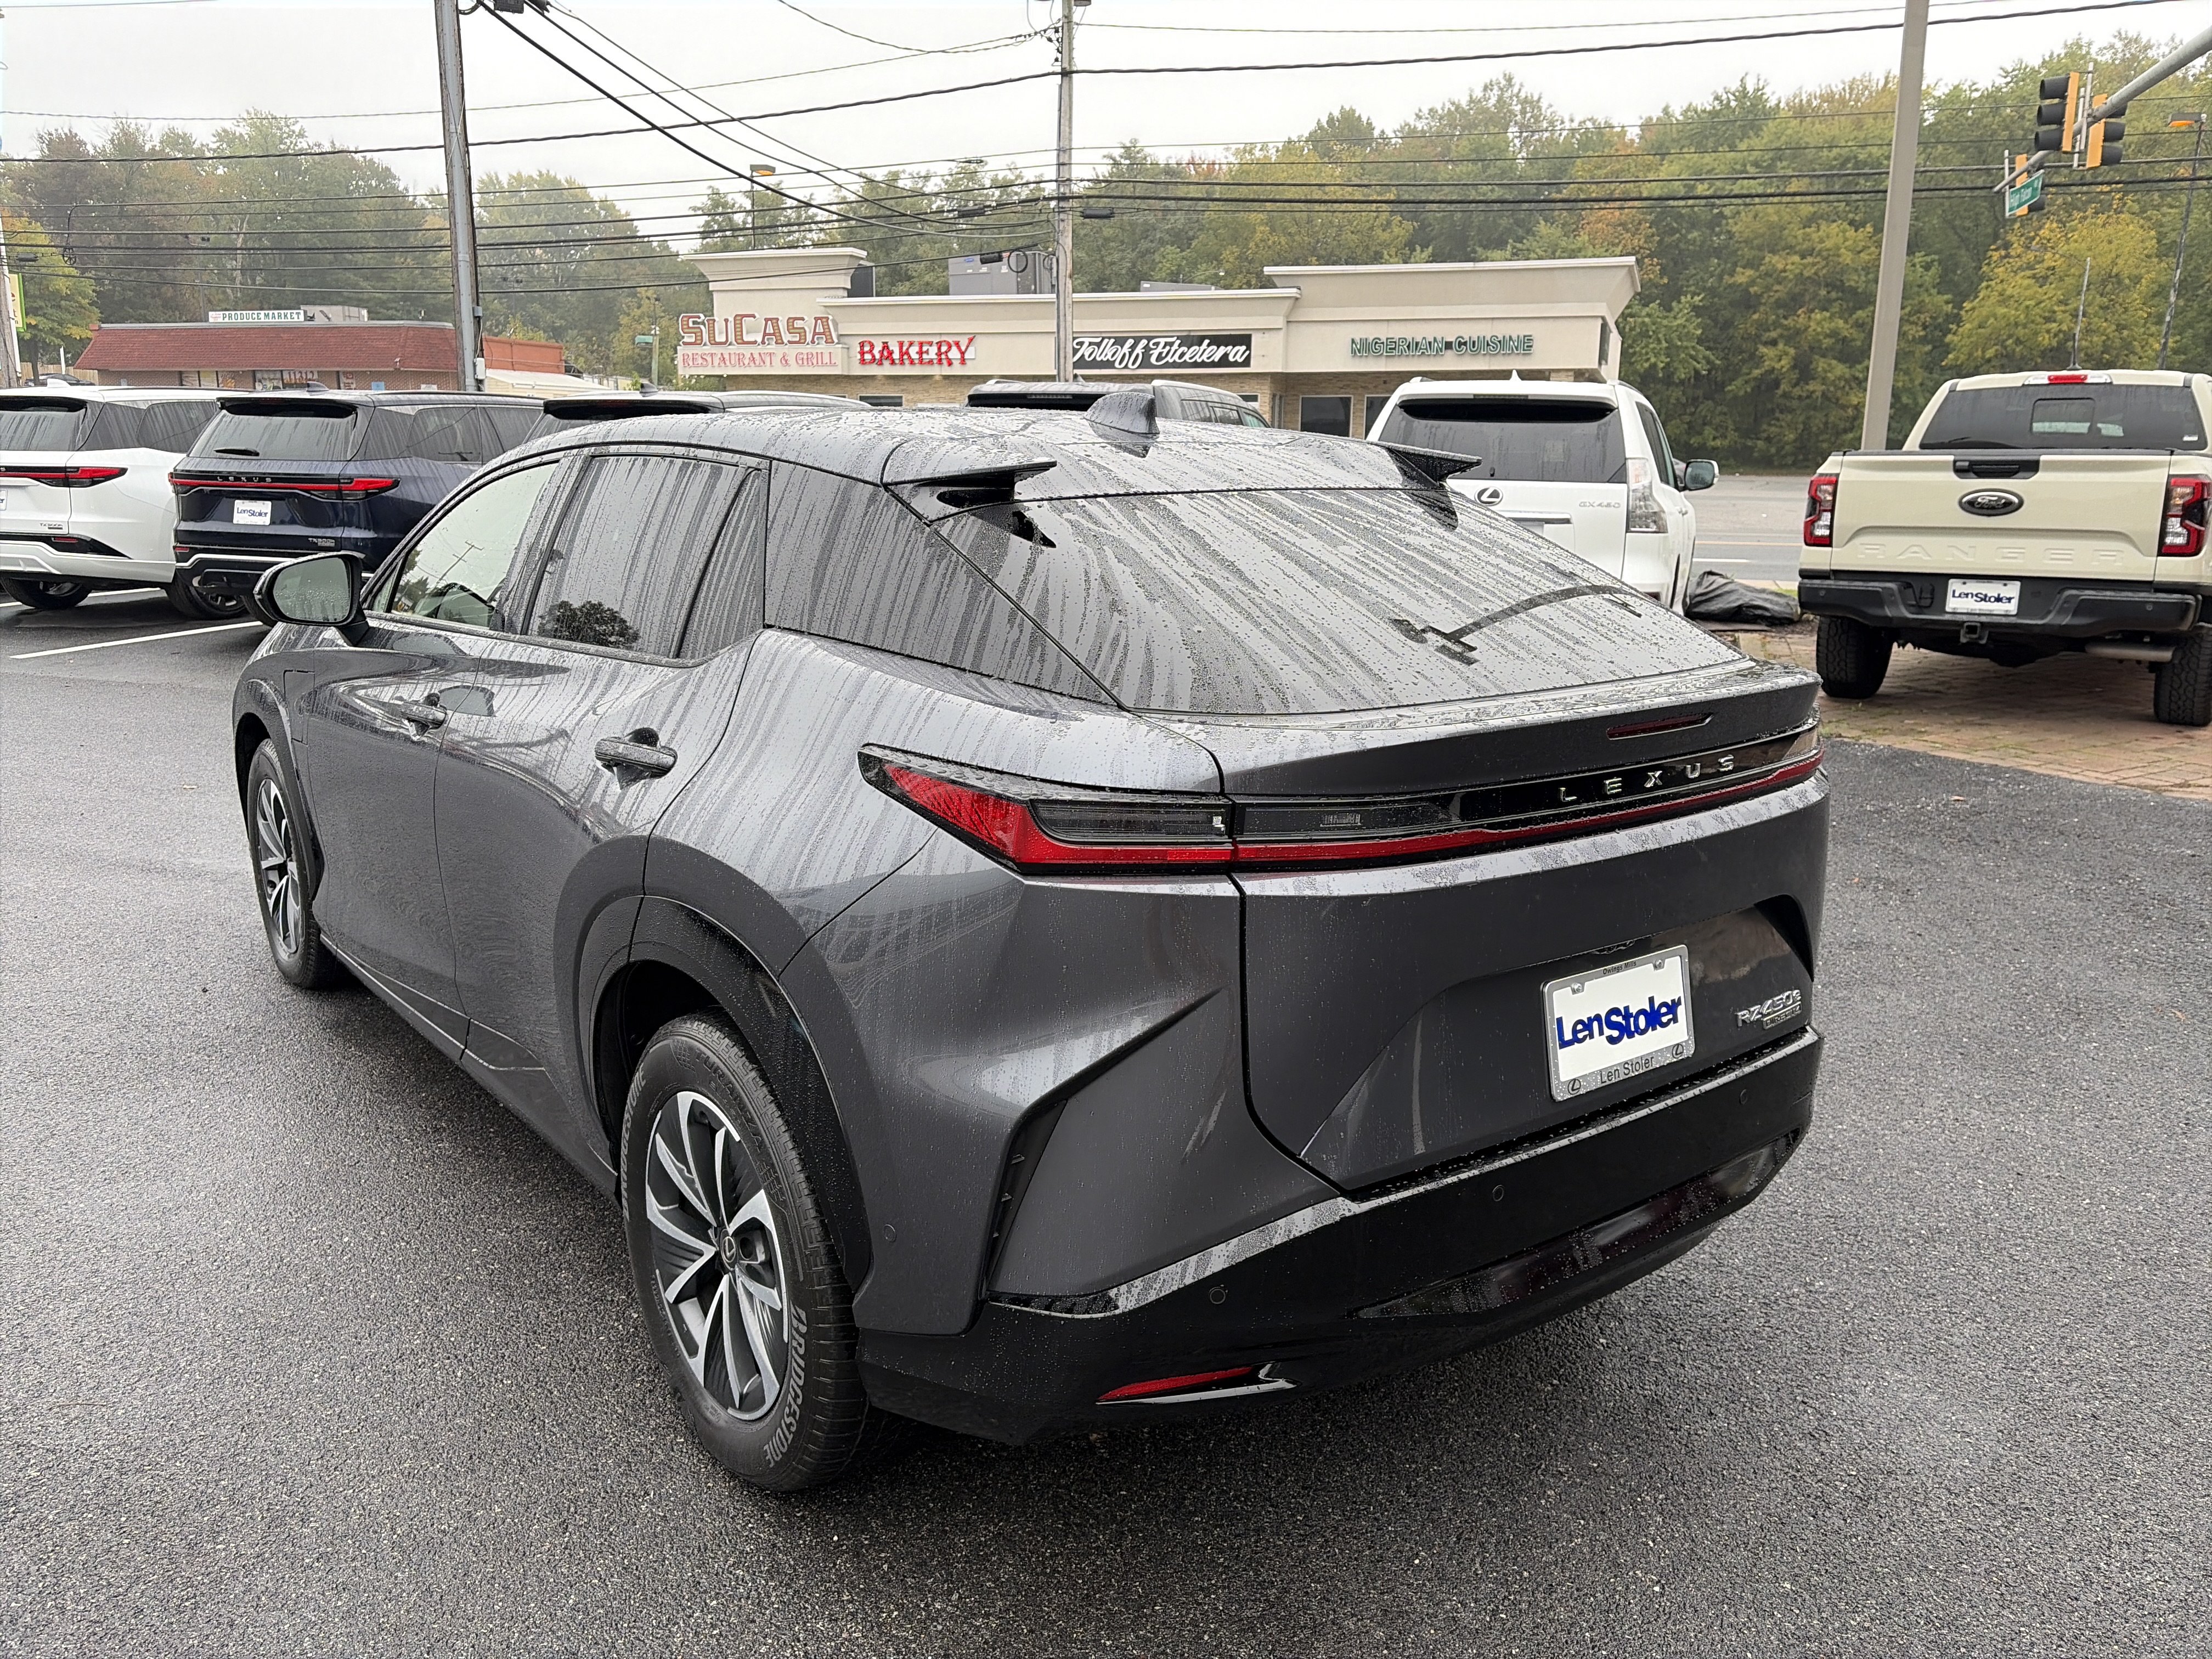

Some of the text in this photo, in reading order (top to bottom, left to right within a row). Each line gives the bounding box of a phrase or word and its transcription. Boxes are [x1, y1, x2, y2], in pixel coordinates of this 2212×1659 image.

[222, 312, 262, 321] PRODUCE
[264, 312, 301, 320] MARKET
[858, 335, 976, 366] BAKERY
[1149, 336, 1250, 365] Etcetera
[1350, 334, 1534, 356] NIGERIAN CUISINE
[682, 351, 838, 368] RESTAURANT & GRILL
[1975, 495, 2006, 508] Ford
[1857, 543, 2125, 566] RANGER
[1560, 754, 1734, 802] LEXUS
[1602, 961, 1637, 975] Owings Mills
[1600, 1056, 1655, 1085] Len Stoler
[763, 1301, 808, 1468] BRIDGESTONE
